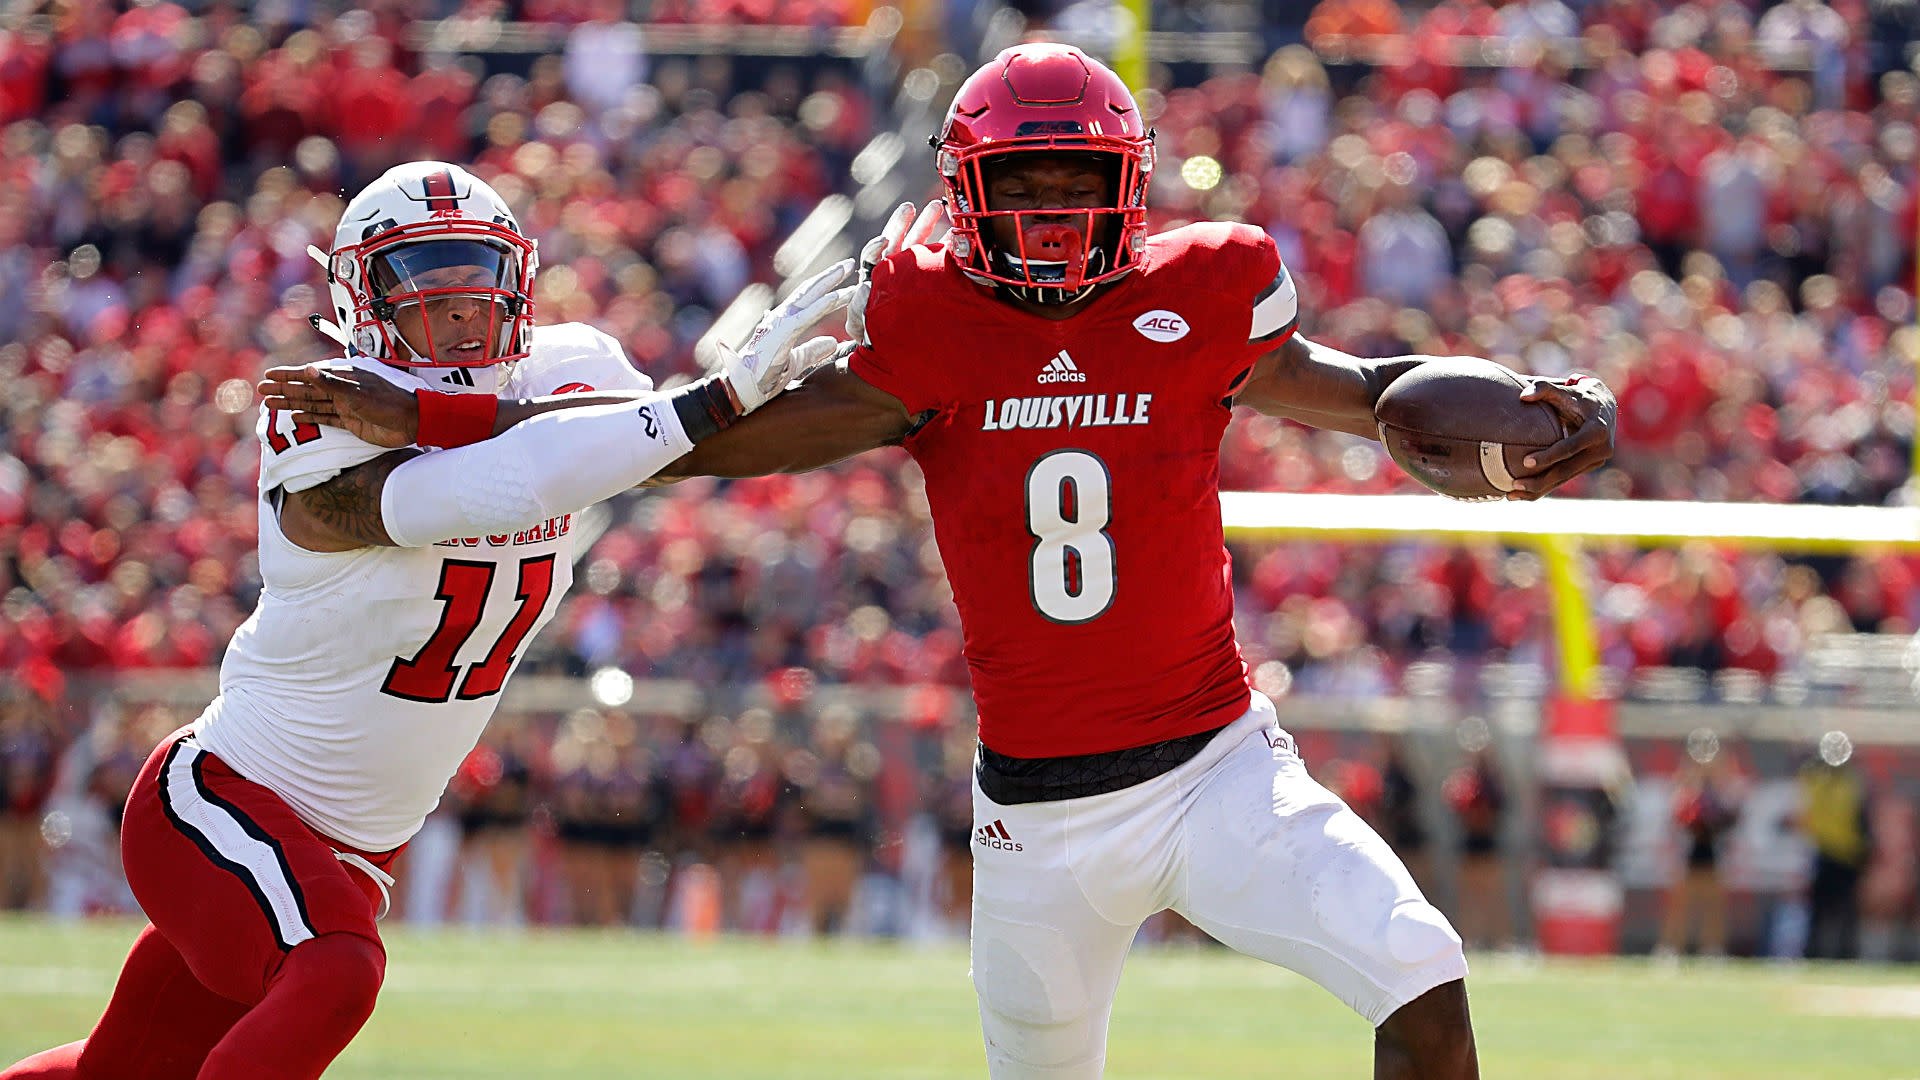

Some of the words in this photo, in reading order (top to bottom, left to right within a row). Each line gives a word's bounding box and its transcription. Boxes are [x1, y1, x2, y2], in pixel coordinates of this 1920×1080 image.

[429, 208, 463, 219] ACC
[1142, 317, 1182, 331] ACC
[1037, 371, 1086, 384] adidas
[981, 393, 1153, 432] LOUISVILLE
[1024, 447, 1118, 626] 8
[379, 552, 557, 703] 11
